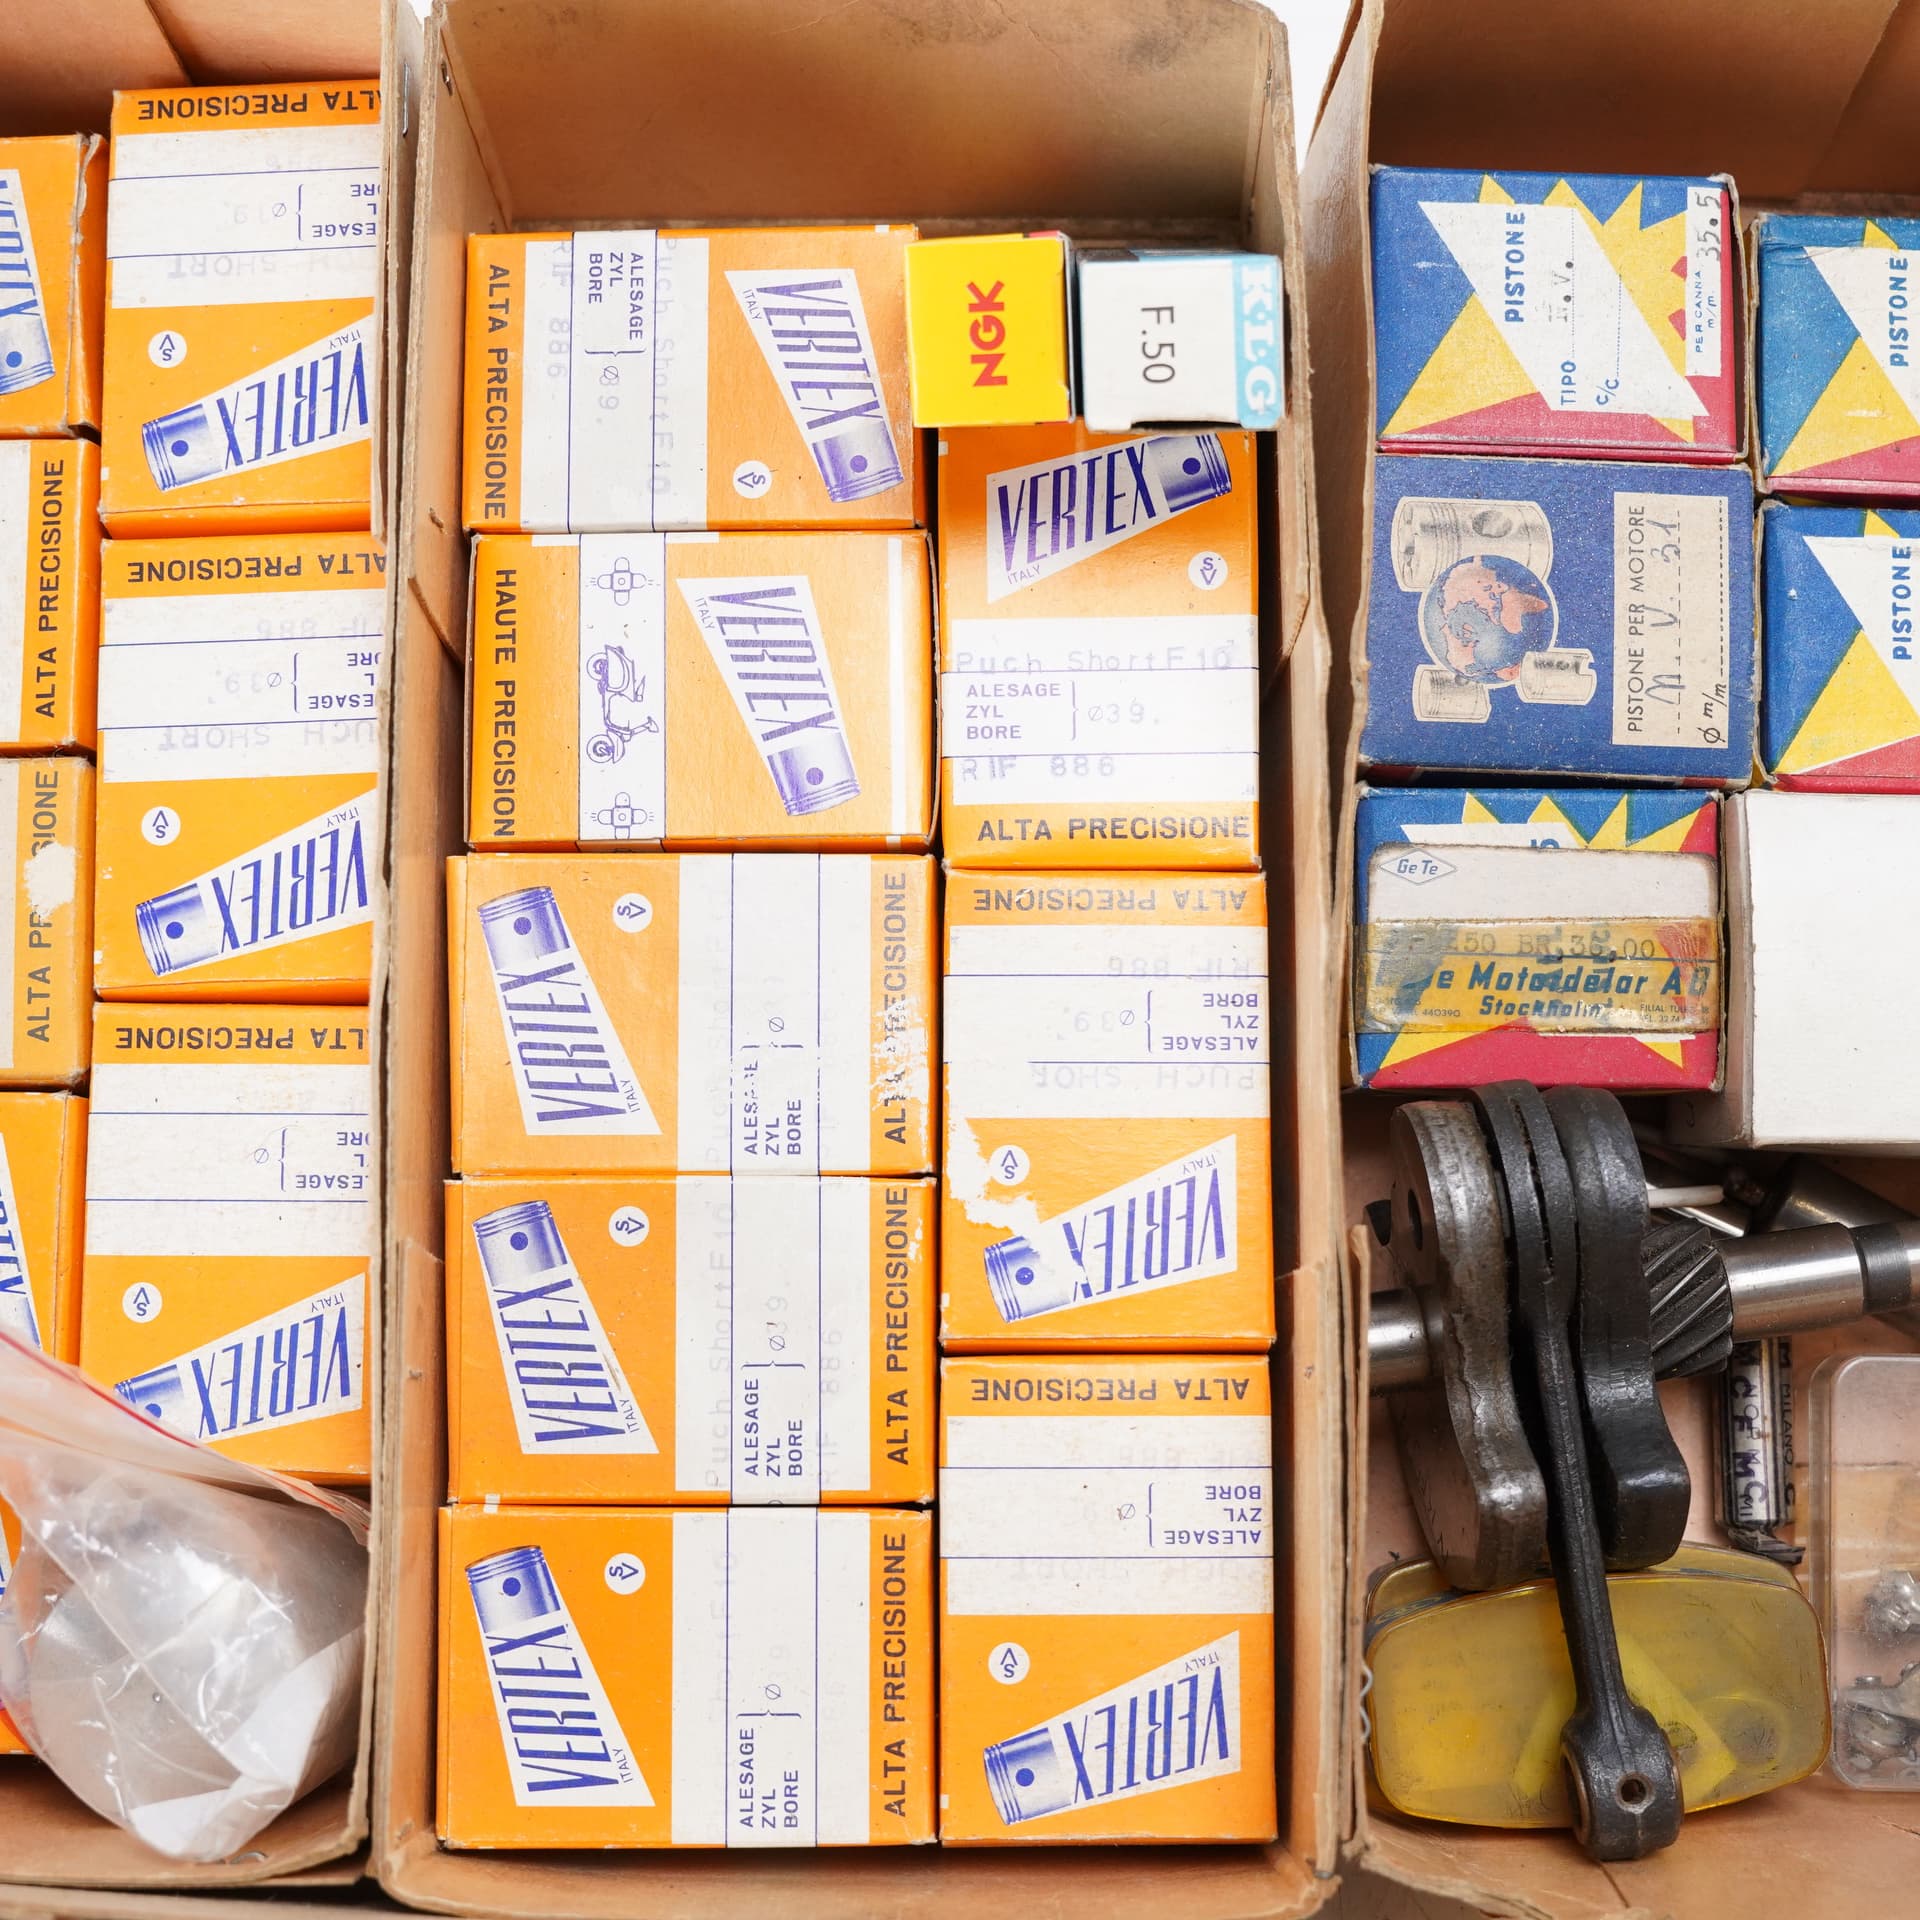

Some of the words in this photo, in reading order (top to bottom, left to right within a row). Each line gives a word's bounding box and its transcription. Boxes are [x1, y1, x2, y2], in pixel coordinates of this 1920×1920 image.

[139, 94, 307, 120] PRECISIONE
[324, 91, 381, 110] LTA
[351, 184, 380, 197] RE
[312, 222, 377, 238] ESAGE
[589, 253, 602, 305] BORE
[609, 252, 623, 286] ZYL
[1504, 211, 1525, 323] PISTONE
[488, 265, 509, 334] ALTA
[630, 252, 644, 340] ALESAGE
[742, 289, 762, 321] ITALY
[1694, 270, 1703, 319] CANNA
[1889, 257, 1908, 367] PISTONE
[328, 330, 360, 349] ITALY
[967, 281, 1007, 387] NGK
[1141, 306, 1175, 383] F.50
[1695, 324, 1703, 353] PER
[757, 280, 884, 430] VERTEX
[1560, 360, 1577, 405] TIPO
[216, 342, 368, 470] VERTEX
[484, 348, 508, 519] PRECISIONE
[997, 442, 1156, 571] VERTEX
[39, 459, 64, 632] PRECISIONE
[1628, 505, 1645, 593] MOTORE
[128, 556, 302, 582] PRECISIONE
[318, 554, 386, 574] ALTA
[1007, 564, 1041, 584] ITALY
[495, 569, 517, 665] HAUTE
[695, 598, 715, 631] ITALY
[1628, 603, 1645, 637] PER
[1892, 546, 1912, 661] PISTONE
[347, 652, 380, 666] RE
[709, 586, 839, 742] VERTEX
[956, 652, 1042, 674] Puch
[35, 647, 57, 718] ALTA
[966, 683, 1061, 697] ALESAGE
[1628, 647, 1646, 733] PISTONE
[308, 693, 374, 710] ESAGE
[966, 705, 1003, 718] ZYL
[303, 720, 376, 745] UCH
[966, 726, 1021, 740] BORE
[493, 680, 516, 837] PRECISION
[1050, 756, 1116, 776] 886
[326, 807, 359, 827] ITALY
[978, 819, 1052, 841] ALTA
[1069, 816, 1250, 840] PRECISIONE
[1397, 858, 1419, 875] Ge
[1420, 860, 1438, 876] Te
[211, 820, 368, 954] VERTEX
[974, 888, 1156, 911] PRECISIONE
[1172, 889, 1247, 911] ALTA
[883, 872, 906, 1053] ECISIONE
[26, 966, 51, 1042] ALTA
[1203, 993, 1258, 1008] BORE
[116, 1026, 294, 1050] PRECISIONE
[311, 1028, 368, 1050] LTA
[1221, 1014, 1258, 1029] ZYL
[496, 961, 626, 1122] VERTEX
[1162, 1035, 1258, 1051] ALESAGE
[620, 1079, 640, 1113] ITALY
[1156, 1065, 1255, 1091] PUCH
[744, 1059, 760, 1155] ALESE
[764, 1117, 780, 1156] ZYL
[786, 1099, 802, 1155] BORE
[295, 1174, 368, 1190] ESAGE
[1182, 1153, 1215, 1175] ITALY
[1062, 1169, 1225, 1302] VERTEX
[885, 1187, 909, 1373] PRECISIONE
[310, 1291, 345, 1312] ITALY
[191, 1307, 350, 1438] VERTEX
[493, 1278, 626, 1442] VERTEX
[970, 1378, 1157, 1400] PRECISIONE
[1175, 1378, 1250, 1400] ALTA
[621, 1398, 640, 1433] ITALY
[744, 1378, 759, 1476] ALESAGE
[885, 1390, 909, 1465] ALTA
[766, 1438, 781, 1477] ZYL
[788, 1418, 803, 1476] BORE
[1205, 1485, 1262, 1501] BORE
[1224, 1507, 1262, 1523] ZYL
[1163, 1530, 1262, 1545] ALESAGE
[883, 1533, 906, 1722] PRECISIONE
[1184, 1651, 1220, 1673] ITALY
[486, 1623, 619, 1792] VERTEX
[1063, 1666, 1229, 1803] VERTEX
[614, 1748, 632, 1784] ITALY
[739, 1728, 755, 1829] ALESAGE
[883, 1739, 906, 1817] ALTA
[761, 1788, 777, 1829] ZYL
[783, 1770, 799, 1829] BORE
